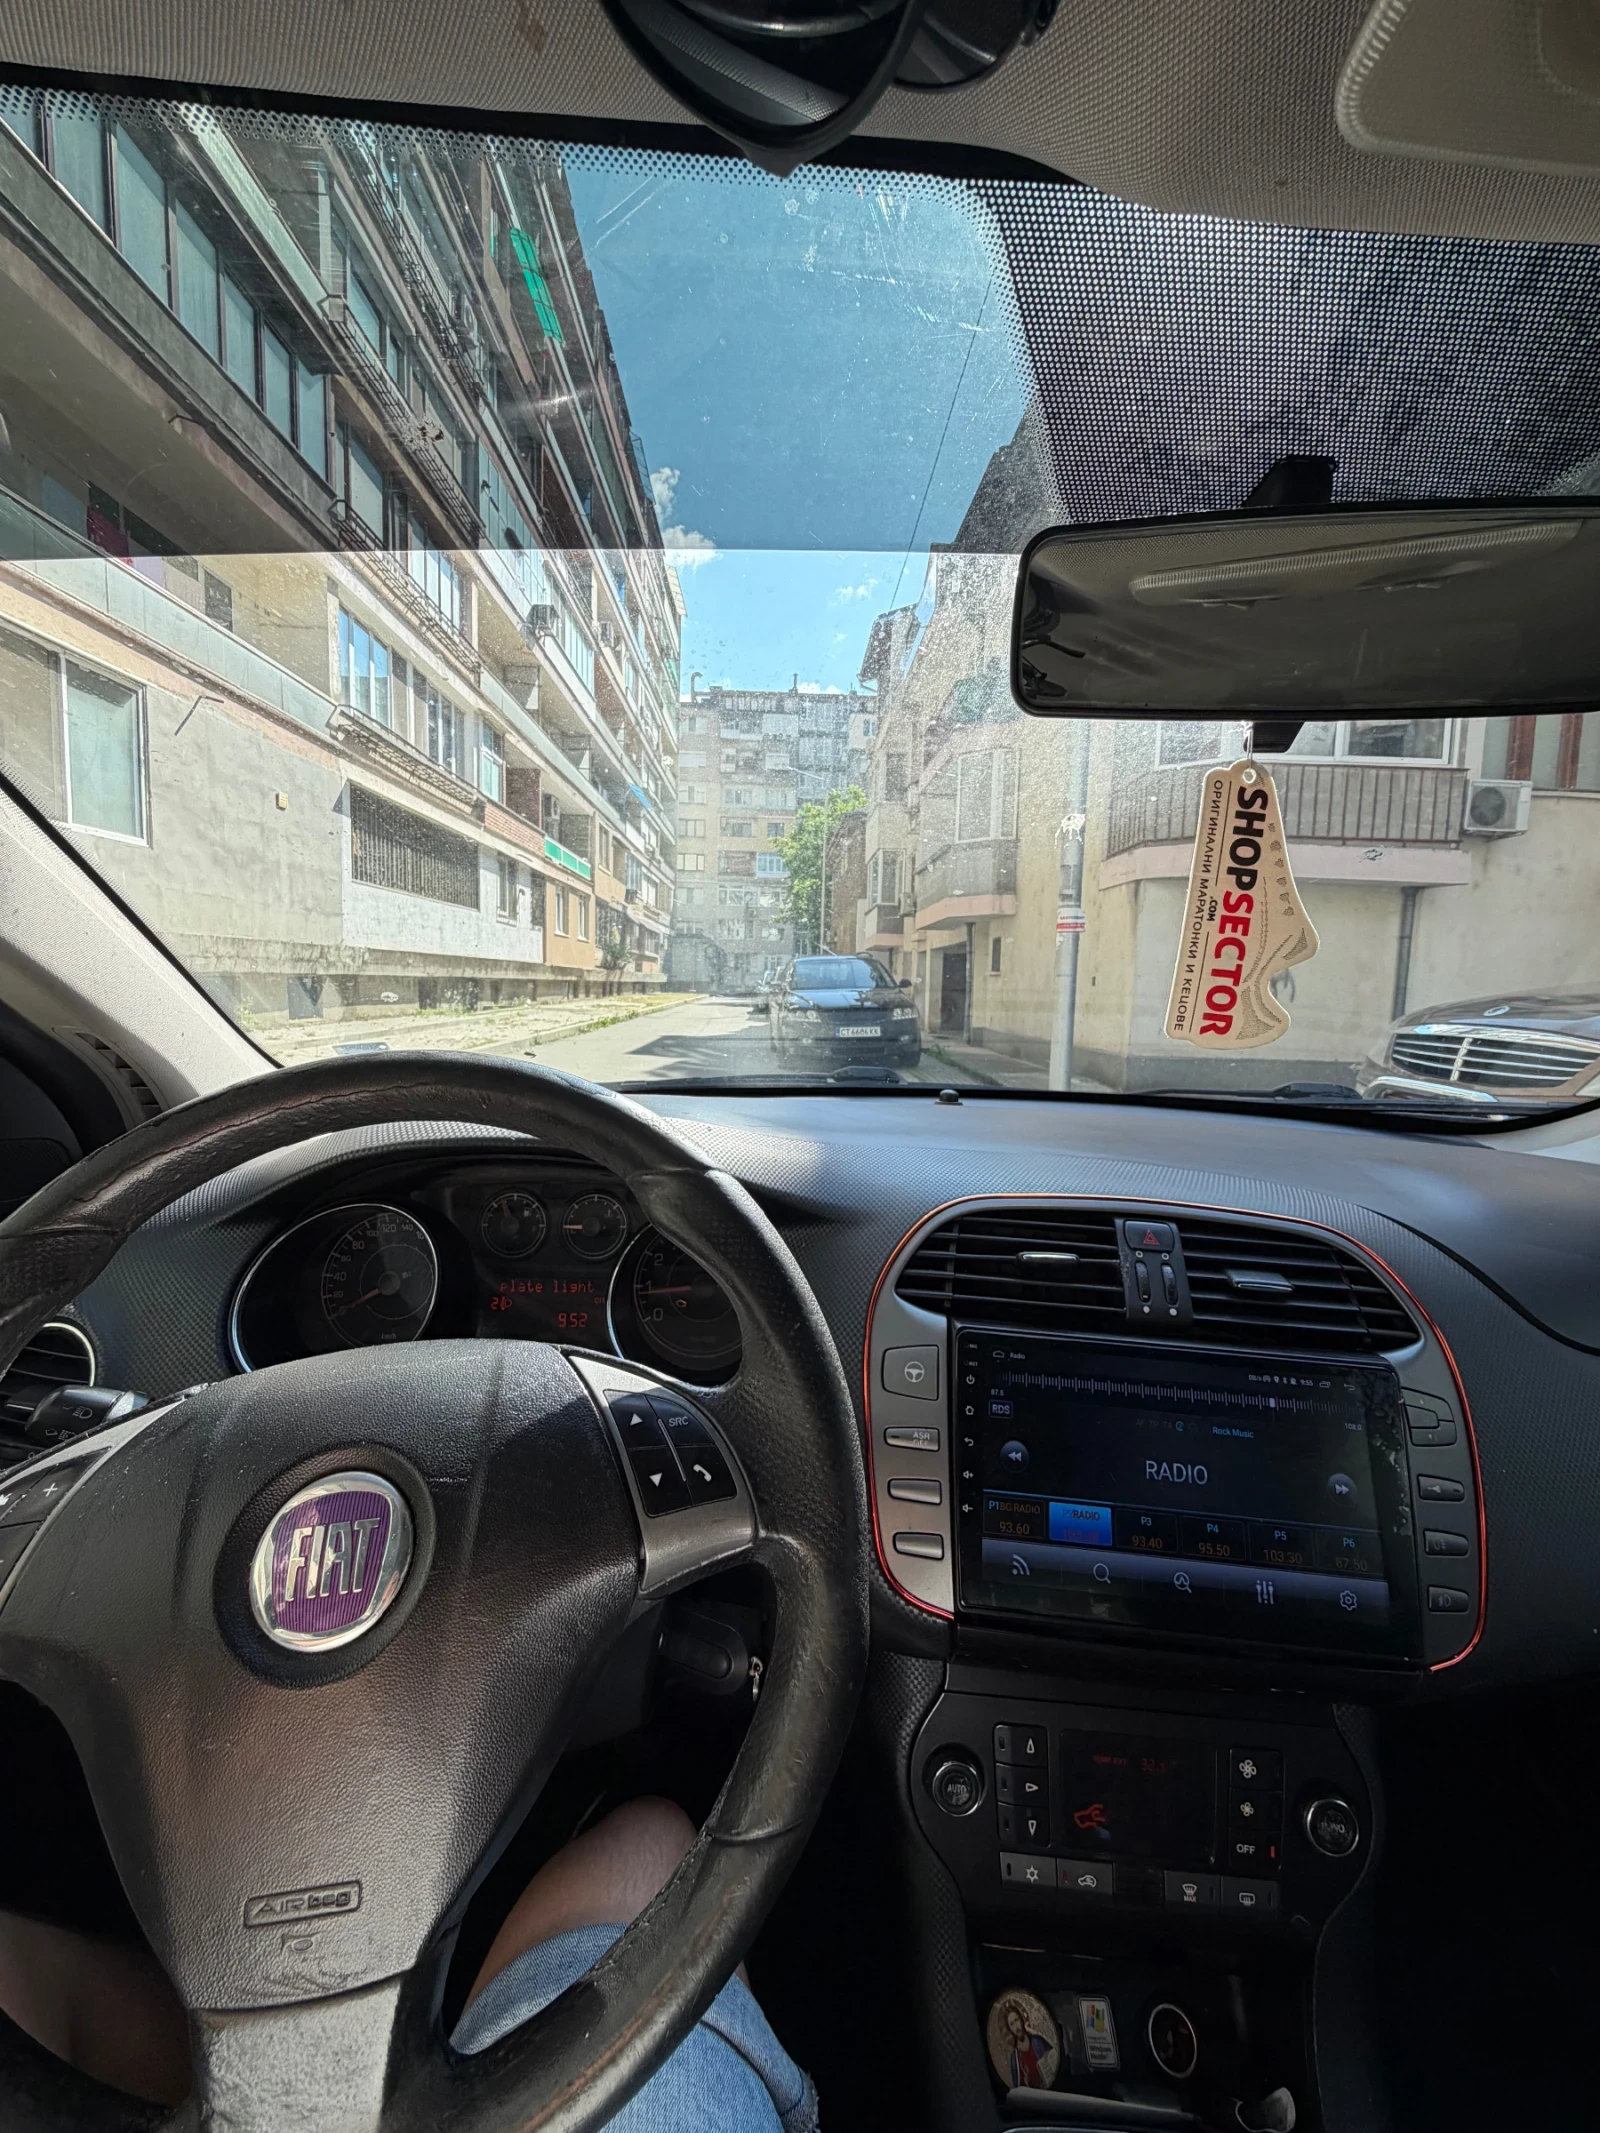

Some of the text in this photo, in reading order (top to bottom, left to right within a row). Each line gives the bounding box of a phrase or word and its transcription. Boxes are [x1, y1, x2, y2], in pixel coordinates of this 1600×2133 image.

[1202, 779, 1224, 874] ОРИГИНАЛНИ
[1199, 786, 1268, 1036] SHOPSECTOR
[1187, 878, 1208, 959] МАРАТОНКИ
[1174, 977, 1193, 1032] КЕЦОВЕ
[382, 1223, 396, 1232] 120
[352, 1241, 365, 1250] 80
[653, 1253, 664, 1266] 2
[333, 1271, 347, 1280] 40
[553, 1280, 594, 1293] light
[653, 1308, 664, 1321] 0
[1009, 1351, 1026, 1360] Radio
[992, 1403, 1010, 1415] RDS
[669, 1416, 688, 1427] SRC
[913, 1431, 930, 1440] ASR
[1212, 1426, 1254, 1439] Rock Music
[1145, 1460, 1208, 1486] RADIO
[1141, 1516, 1152, 1526] P3
[999, 1520, 1030, 1536] 93.60
[1206, 1523, 1220, 1534] P4
[1274, 1530, 1287, 1541] P5
[1132, 1535, 1163, 1550] 93.40
[1342, 1537, 1355, 1548] P6
[1198, 1542, 1230, 1557] 95.50
[286, 1517, 381, 1602] FIAT
[1263, 1549, 1302, 1565] 103.30
[947, 1784, 967, 1793] AUTO
[1236, 1843, 1255, 1854] OFF
[1183, 1895, 1197, 1903] MAX
